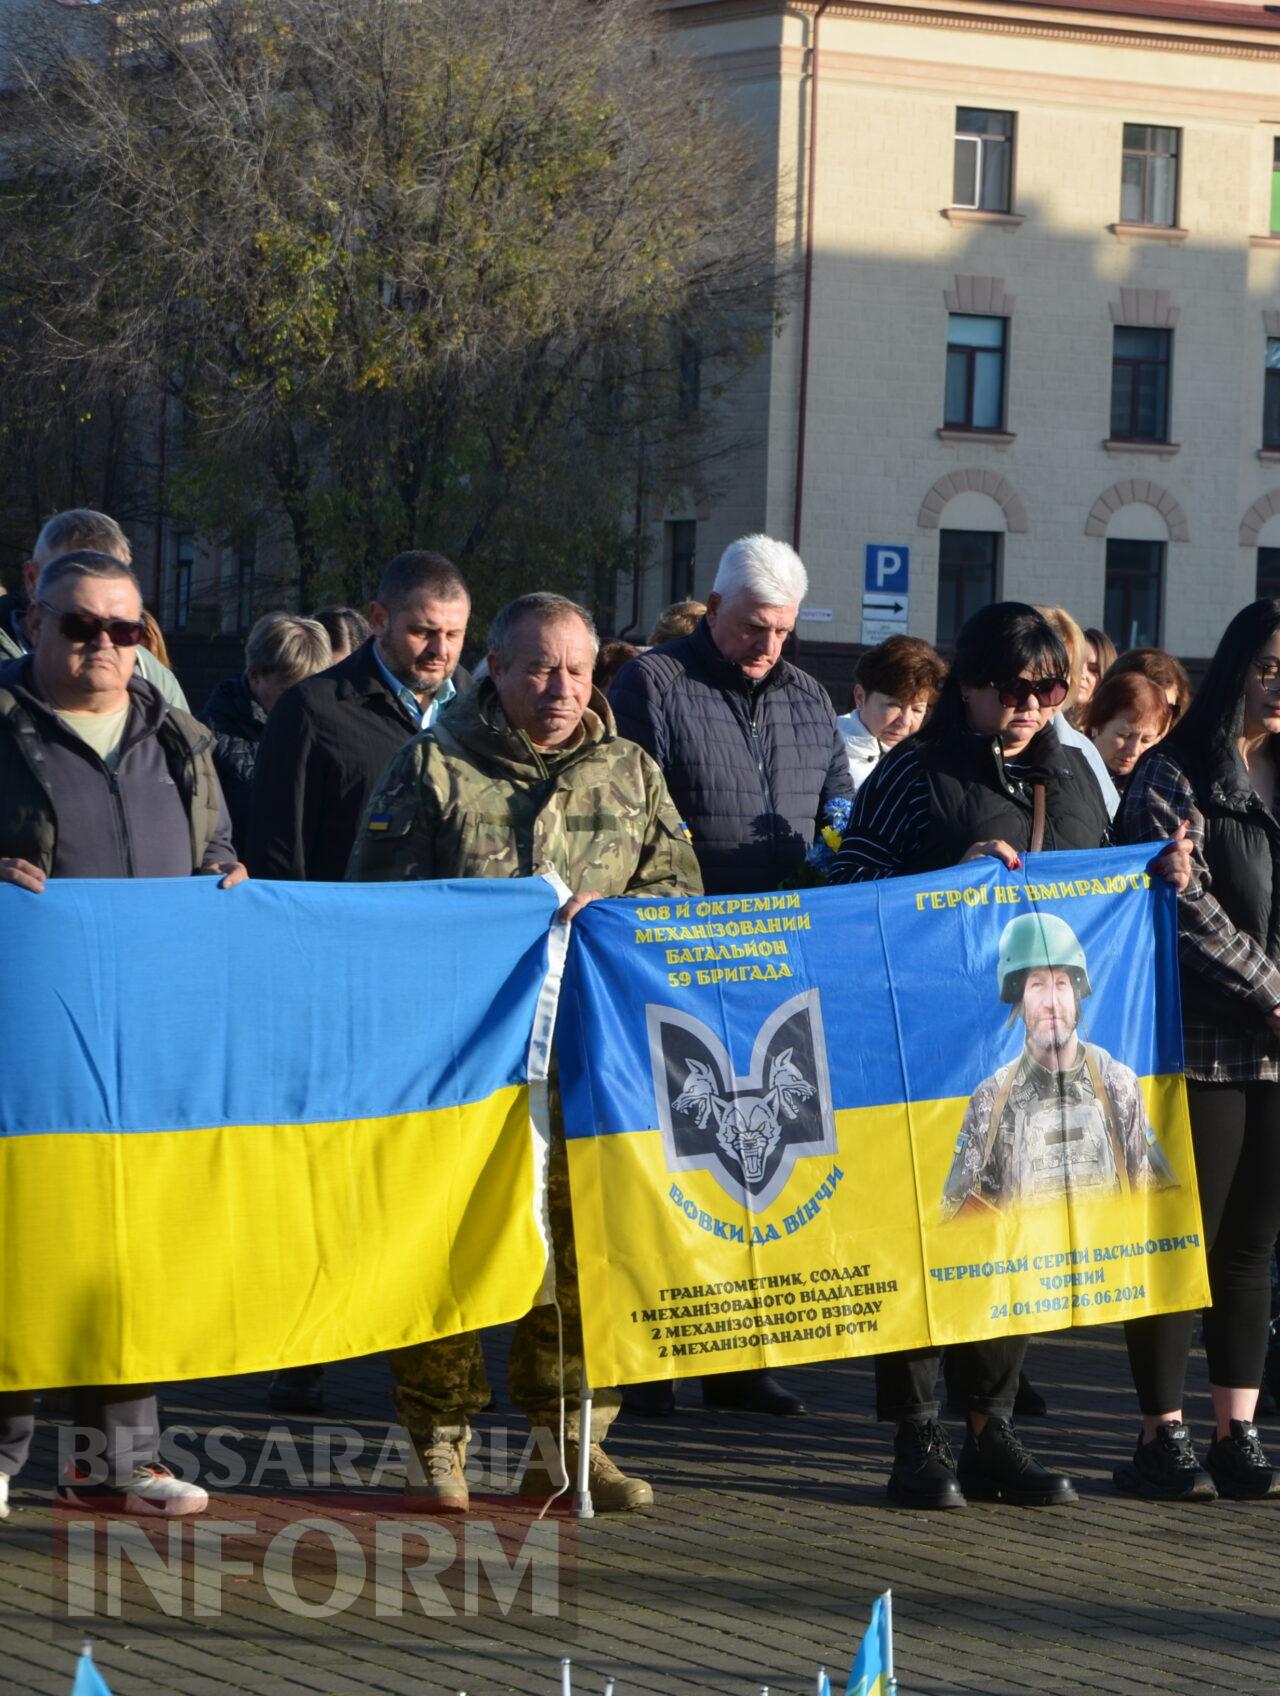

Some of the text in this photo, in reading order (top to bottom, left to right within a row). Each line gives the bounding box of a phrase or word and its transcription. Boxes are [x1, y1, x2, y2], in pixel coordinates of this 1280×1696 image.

[876, 550, 901, 587] P
[635, 906, 671, 921] 108
[696, 892, 800, 917] ОКРЕМИЙ
[915, 883, 989, 911] ГЕРОЇ
[994, 886, 1021, 904] НЕ
[634, 912, 811, 944] МЕХАНІЗОВАНИЙ
[665, 939, 788, 965] БАТАЛЬЙОН
[668, 963, 793, 988] 59 БРИГАДА
[669, 1163, 844, 1247] ВОВКИ ДА ВІНЧИ
[930, 1255, 1028, 1282] ЧЕРНОБАЙ
[1093, 1233, 1200, 1262] ВАСИЛЬОВИЧ
[659, 1264, 871, 1302] ГРАНАТОМЕТНИК, СОЛДАТ
[1040, 1266, 1105, 1290] ЧОРНИЙ
[631, 1279, 898, 1323] 1 МЕХАНІЗОВАНОГО ВІДДІЛЕННЯ
[651, 1301, 883, 1340] 2 МЕХАНІЗОВАНОГО ВЗВОДУ
[658, 1345, 668, 1358] 2
[835, 1319, 878, 1337] РОТИ
